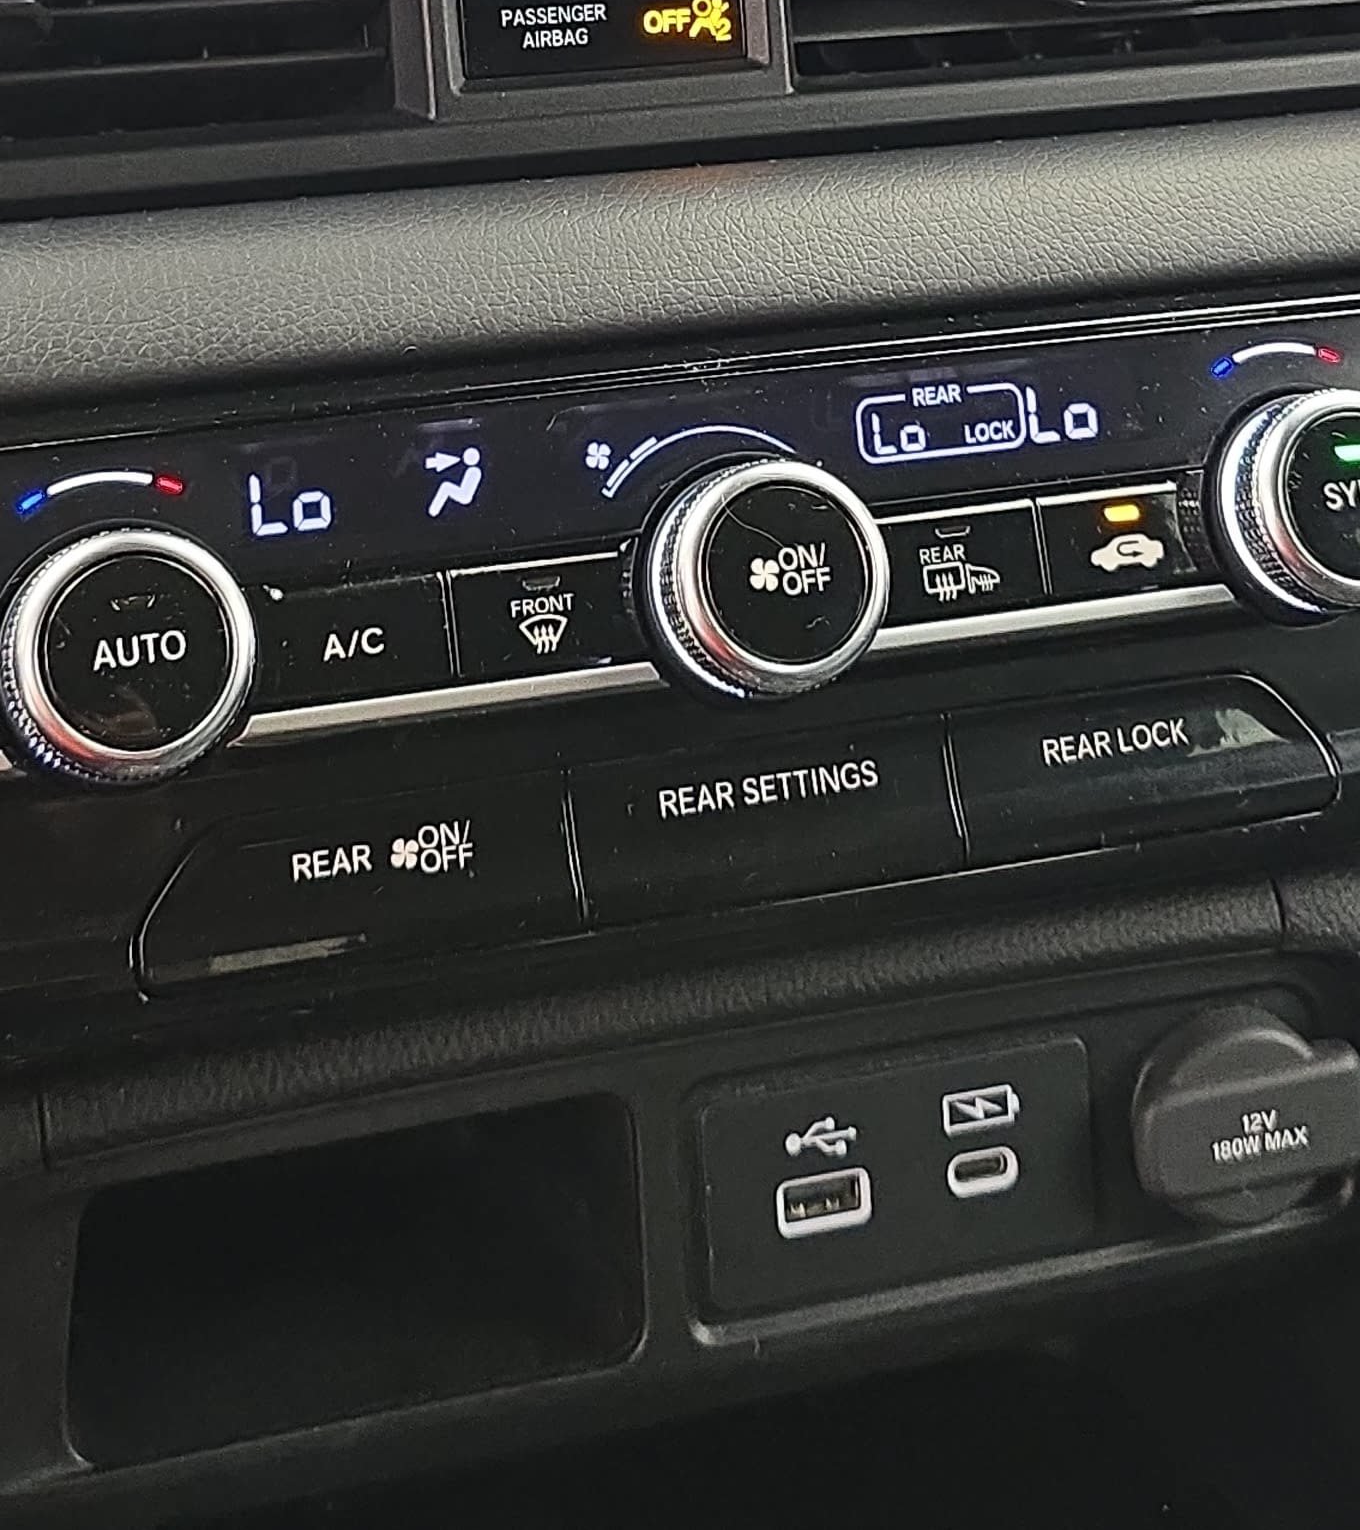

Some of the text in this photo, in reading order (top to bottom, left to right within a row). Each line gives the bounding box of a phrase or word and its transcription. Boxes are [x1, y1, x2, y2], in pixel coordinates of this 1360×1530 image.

[501, 4, 607, 27] PASSENGER
[644, 10, 691, 33] OFF
[523, 29, 588, 49] AIRBAG
[912, 384, 961, 407] REAR
[1026, 387, 1098, 444] Lo
[964, 419, 1015, 444] LOCK
[248, 474, 332, 537] Lo
[919, 545, 965, 564] REAR
[782, 569, 830, 596] OFF
[510, 594, 574, 618] FRONT
[93, 631, 187, 671] AUTO
[323, 627, 385, 661] A/C
[1042, 717, 1189, 766] REAR LOCK
[658, 759, 879, 819] REAR SETTINGS
[292, 845, 371, 882] REAR
[420, 843, 473, 874] OFF
[1242, 1110, 1277, 1133] 12V
[1212, 1126, 1308, 1162] 180W MAX
